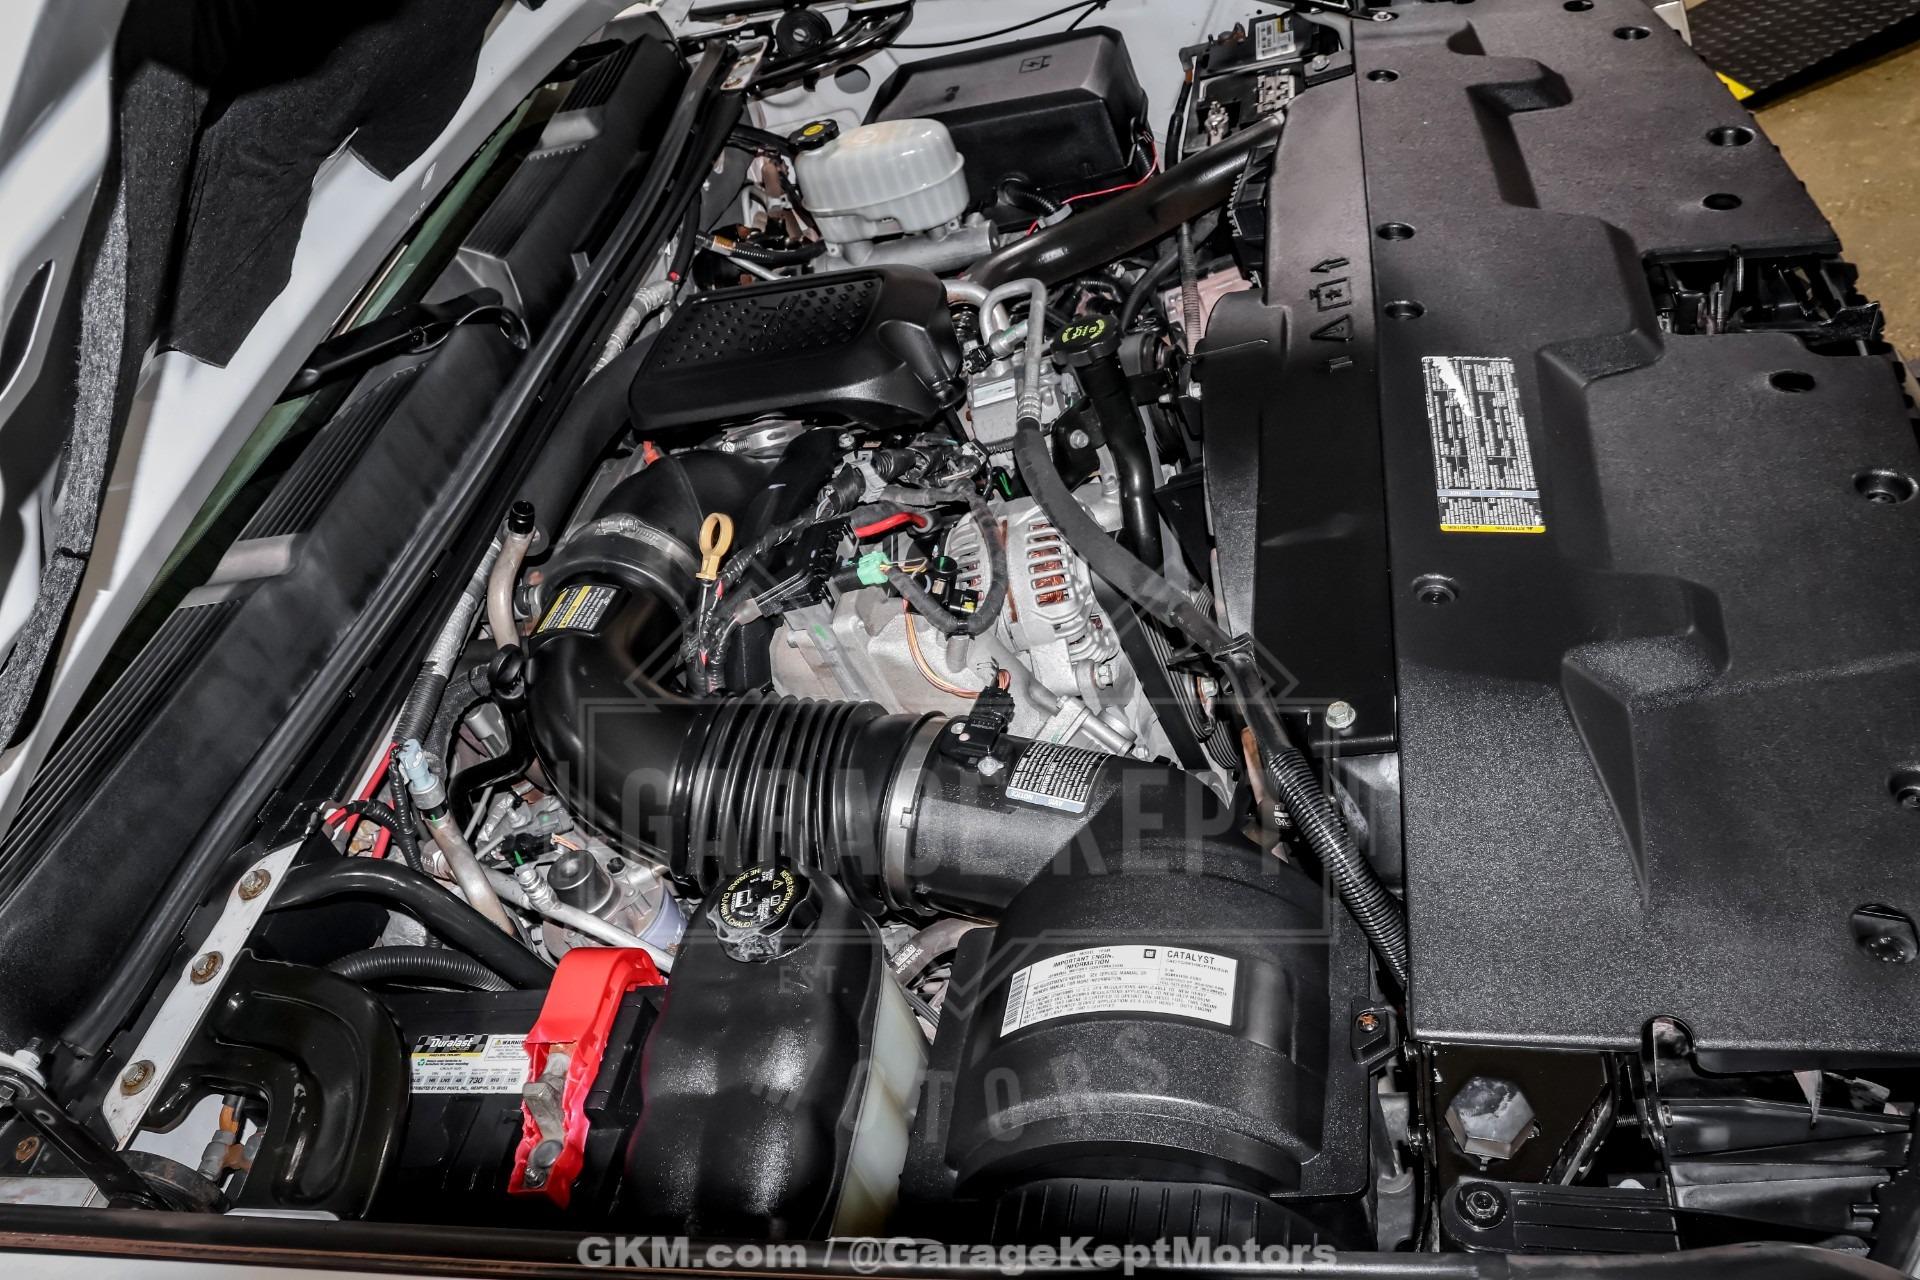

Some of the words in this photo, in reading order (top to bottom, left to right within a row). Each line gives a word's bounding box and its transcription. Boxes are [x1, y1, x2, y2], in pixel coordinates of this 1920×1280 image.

[1053, 956, 1090, 968] IMPORTANT
[1167, 950, 1215, 965] CATALYST
[1065, 958, 1110, 970] INFORMATION
[430, 1037, 474, 1048] Duralast
